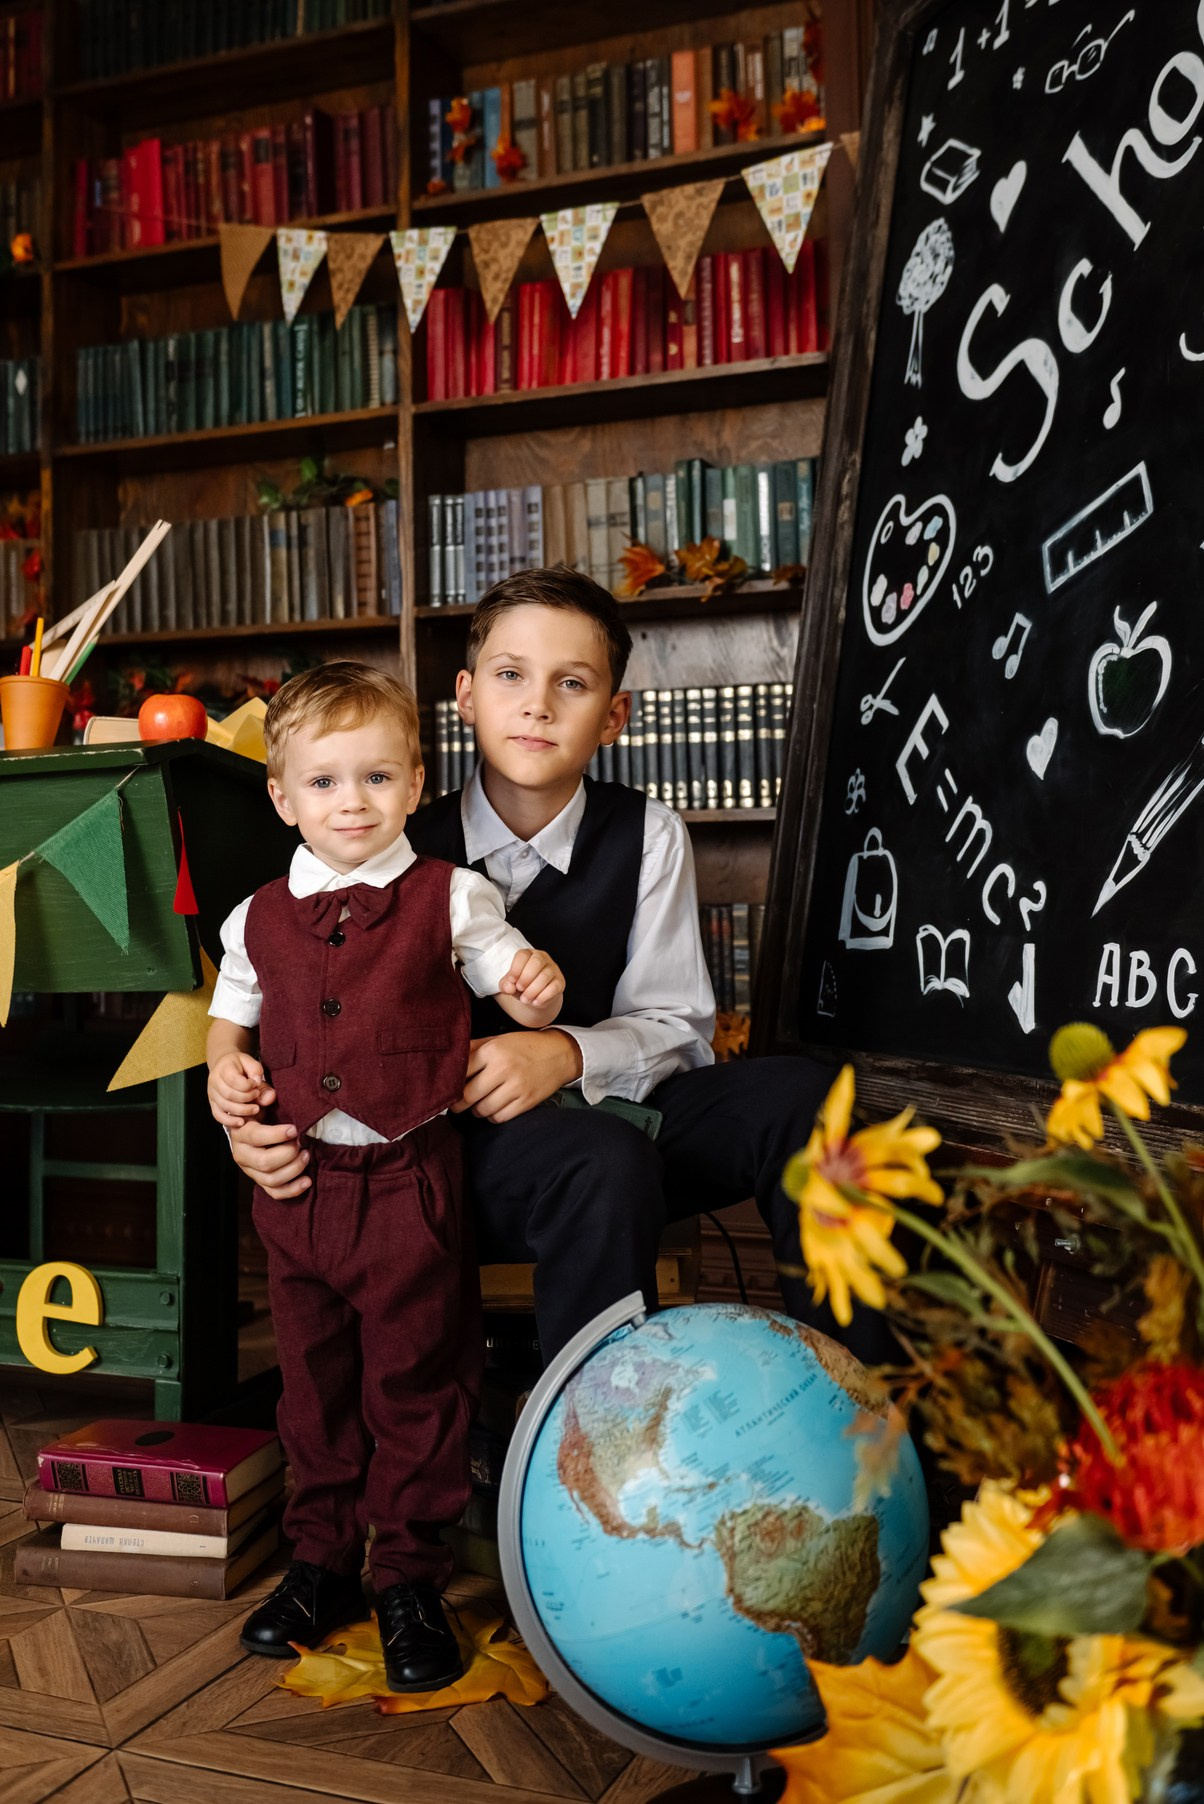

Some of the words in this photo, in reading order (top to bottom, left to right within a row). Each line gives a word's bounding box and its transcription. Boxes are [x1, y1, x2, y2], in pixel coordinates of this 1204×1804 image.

[957, 0, 1204, 482] Scho
[951, 545, 994, 610] 123
[1092, 941, 1199, 1019] ABC
[15, 1262, 103, 1375] e
